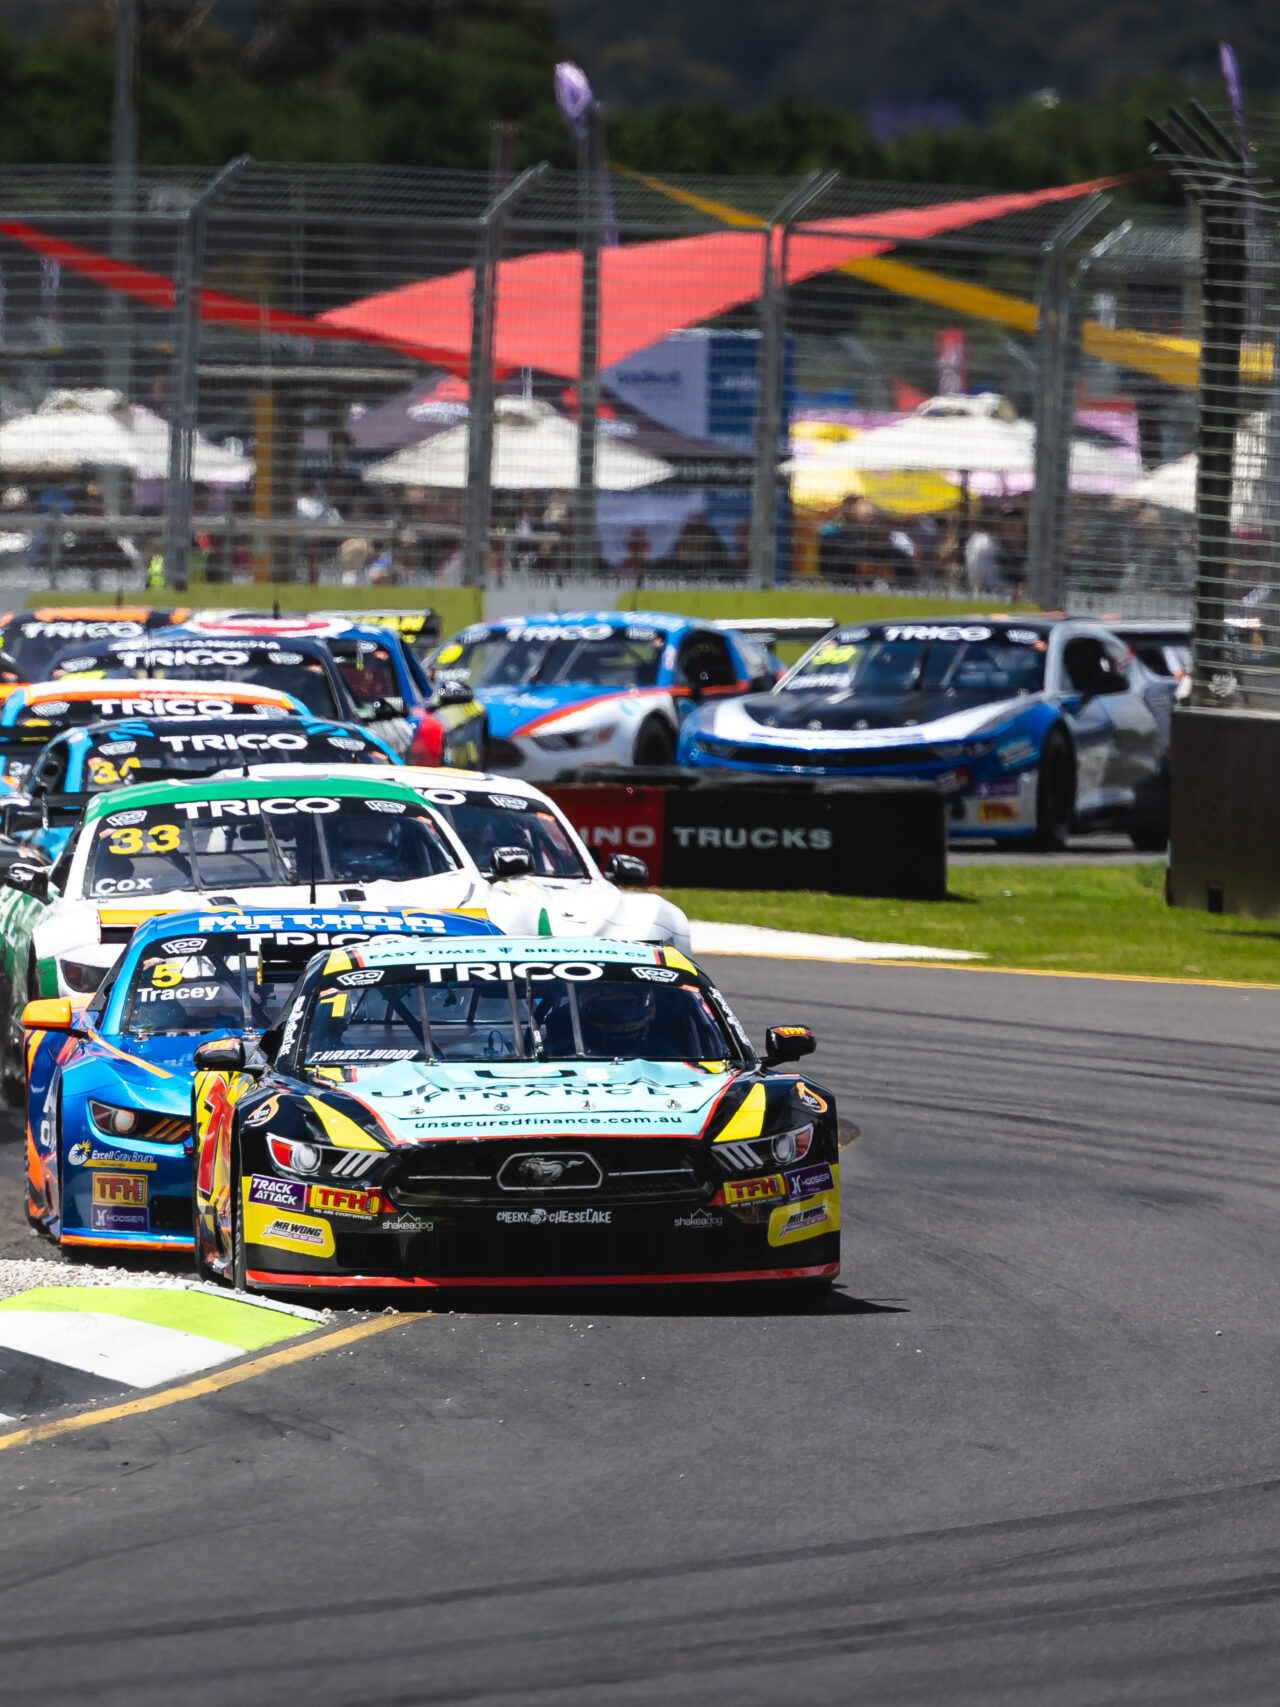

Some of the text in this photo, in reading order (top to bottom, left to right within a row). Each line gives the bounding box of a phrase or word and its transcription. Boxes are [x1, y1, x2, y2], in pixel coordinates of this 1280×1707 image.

[20, 621, 145, 638] TRICO
[117, 650, 249, 668] TRICO
[91, 699, 234, 715] TRICO
[159, 734, 308, 752] TRICO
[174, 798, 340, 819] TRICO
[108, 825, 180, 855] 33
[578, 826, 833, 851] INO TRUCKS
[95, 877, 152, 895] Cox
[199, 914, 446, 929] METHOD
[370, 951, 417, 959] EASY
[427, 948, 487, 956] TIMES
[151, 964, 181, 987] 5
[415, 962, 604, 983] TRICO
[137, 985, 220, 1002] Tracey
[320, 993, 348, 1018] 1
[308, 1049, 420, 1062] T.HAZELWOOD
[423, 1087, 670, 1103] FINANCE
[415, 1115, 682, 1129] unsecuredfinance.com.au
[96, 1177, 139, 1201] TFH
[252, 1177, 295, 1195] TRACK
[730, 1178, 776, 1199] TFH
[254, 1189, 299, 1206] ATTACK
[318, 1188, 367, 1211] TFH
[273, 1220, 291, 1231] MR
[290, 1223, 323, 1237] WONG
